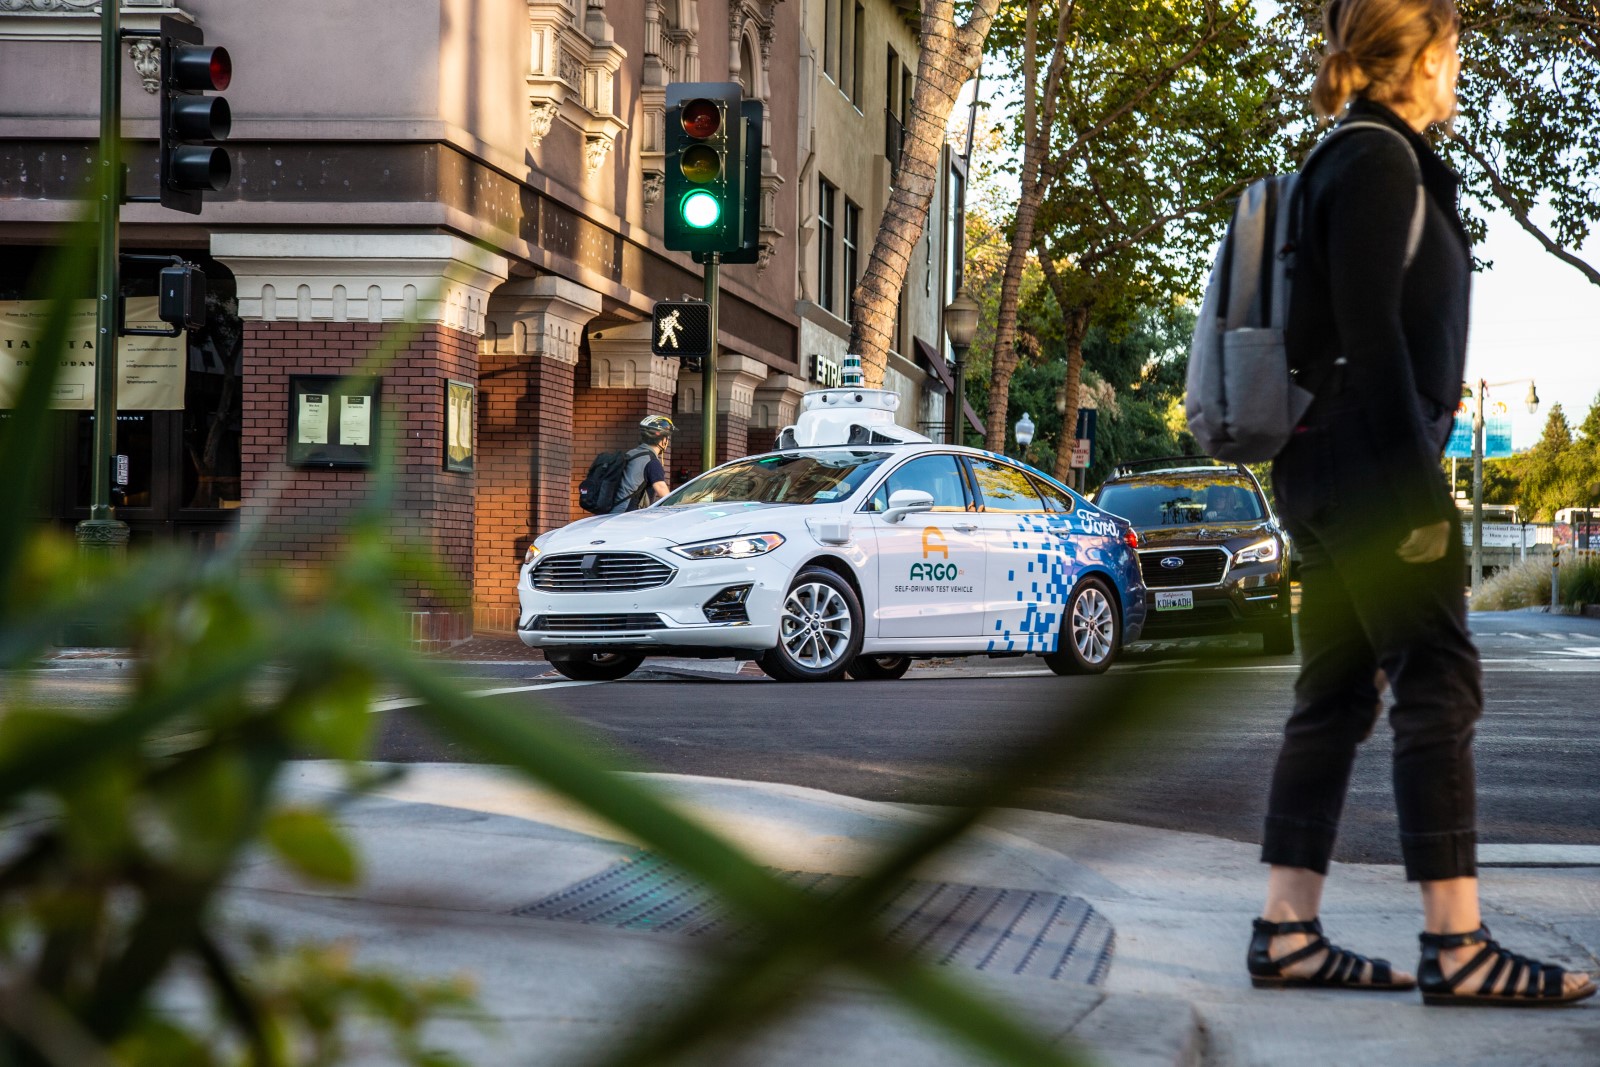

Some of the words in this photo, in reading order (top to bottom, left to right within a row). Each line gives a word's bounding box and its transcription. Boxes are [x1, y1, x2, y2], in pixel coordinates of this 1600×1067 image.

[67, 341, 94, 349] TA
[1076, 508, 1120, 537] Ford
[910, 562, 957, 581] ARGO
